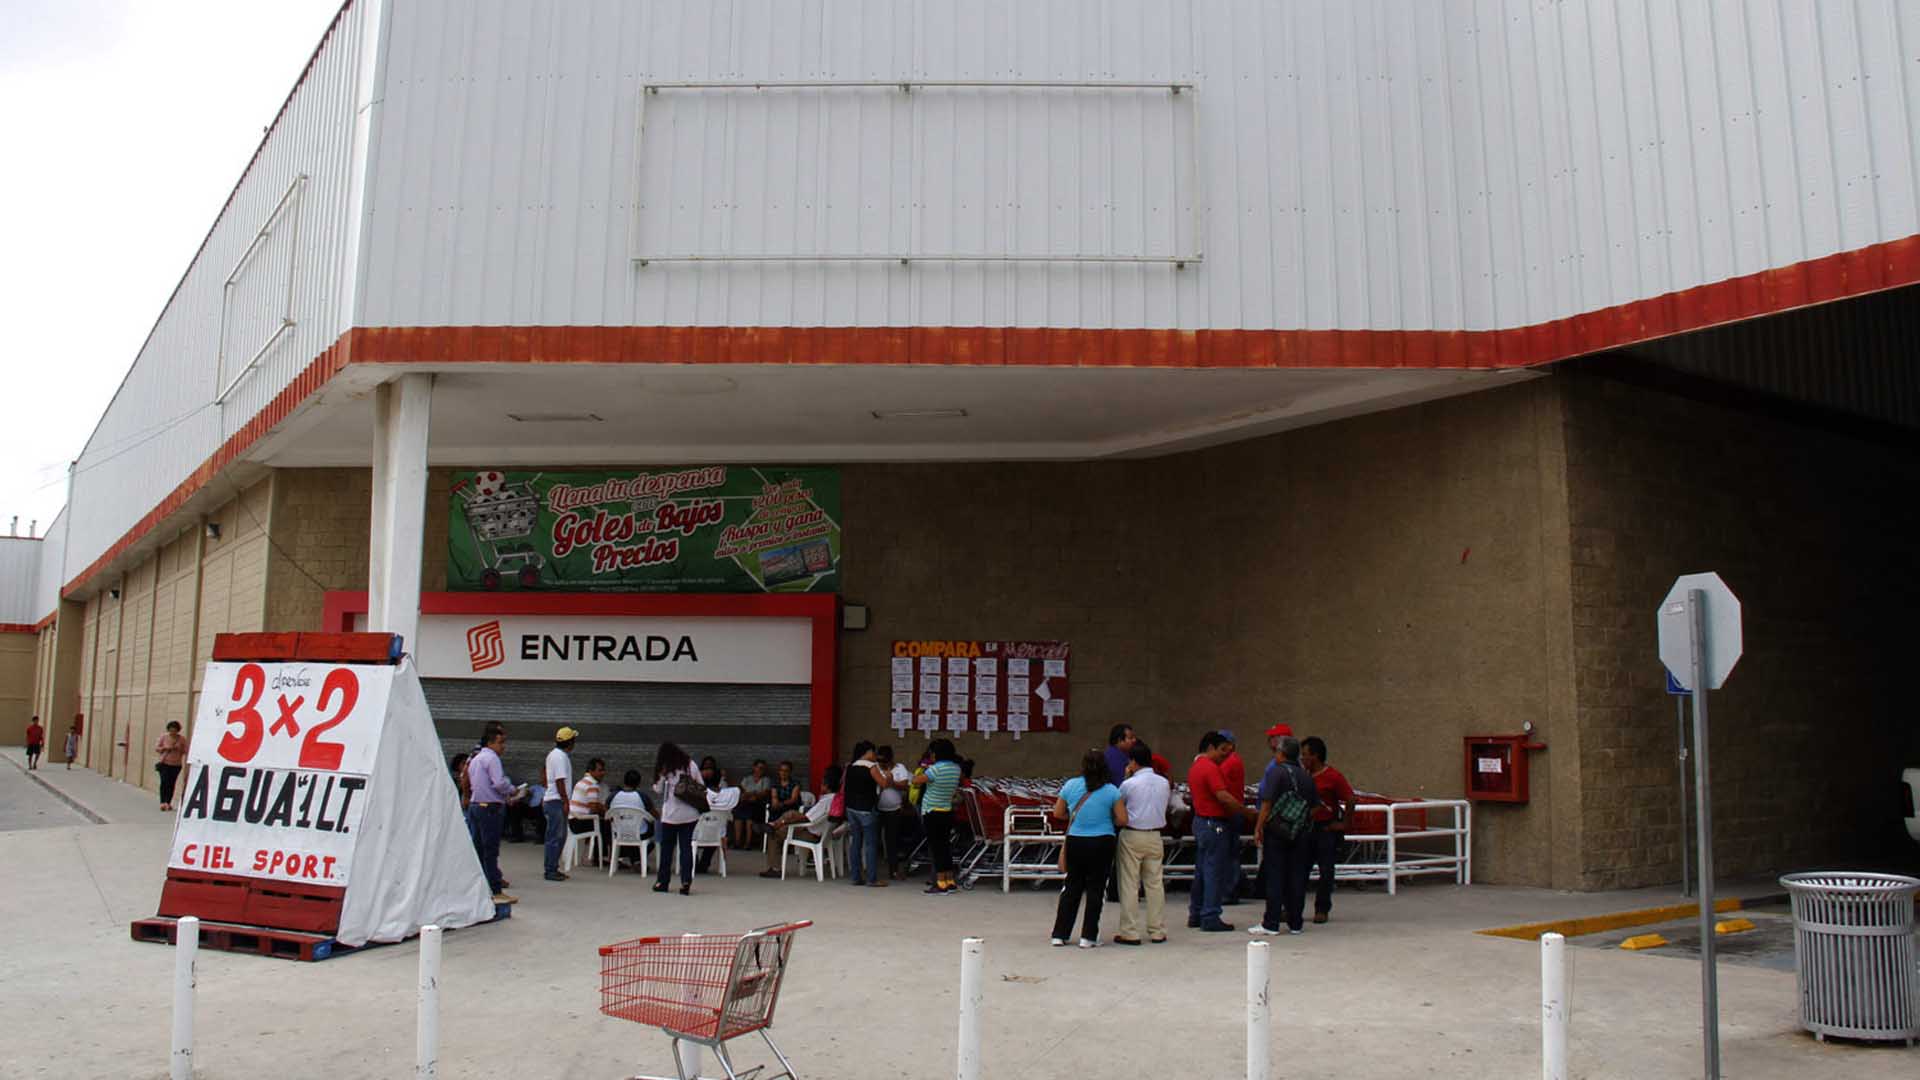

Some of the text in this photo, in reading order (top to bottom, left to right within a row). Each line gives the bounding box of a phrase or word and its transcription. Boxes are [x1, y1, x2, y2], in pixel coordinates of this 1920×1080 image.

[549, 466, 725, 512] Llena tu despensa
[553, 499, 724, 557] Goles de Bajos
[785, 510, 823, 530] gana
[593, 536, 680, 574] Precios
[521, 634, 699, 662] ENTRADA
[894, 641, 981, 657] COMPARA
[183, 764, 297, 827] AGUA
[182, 844, 337, 879] CIEL SPORT.
